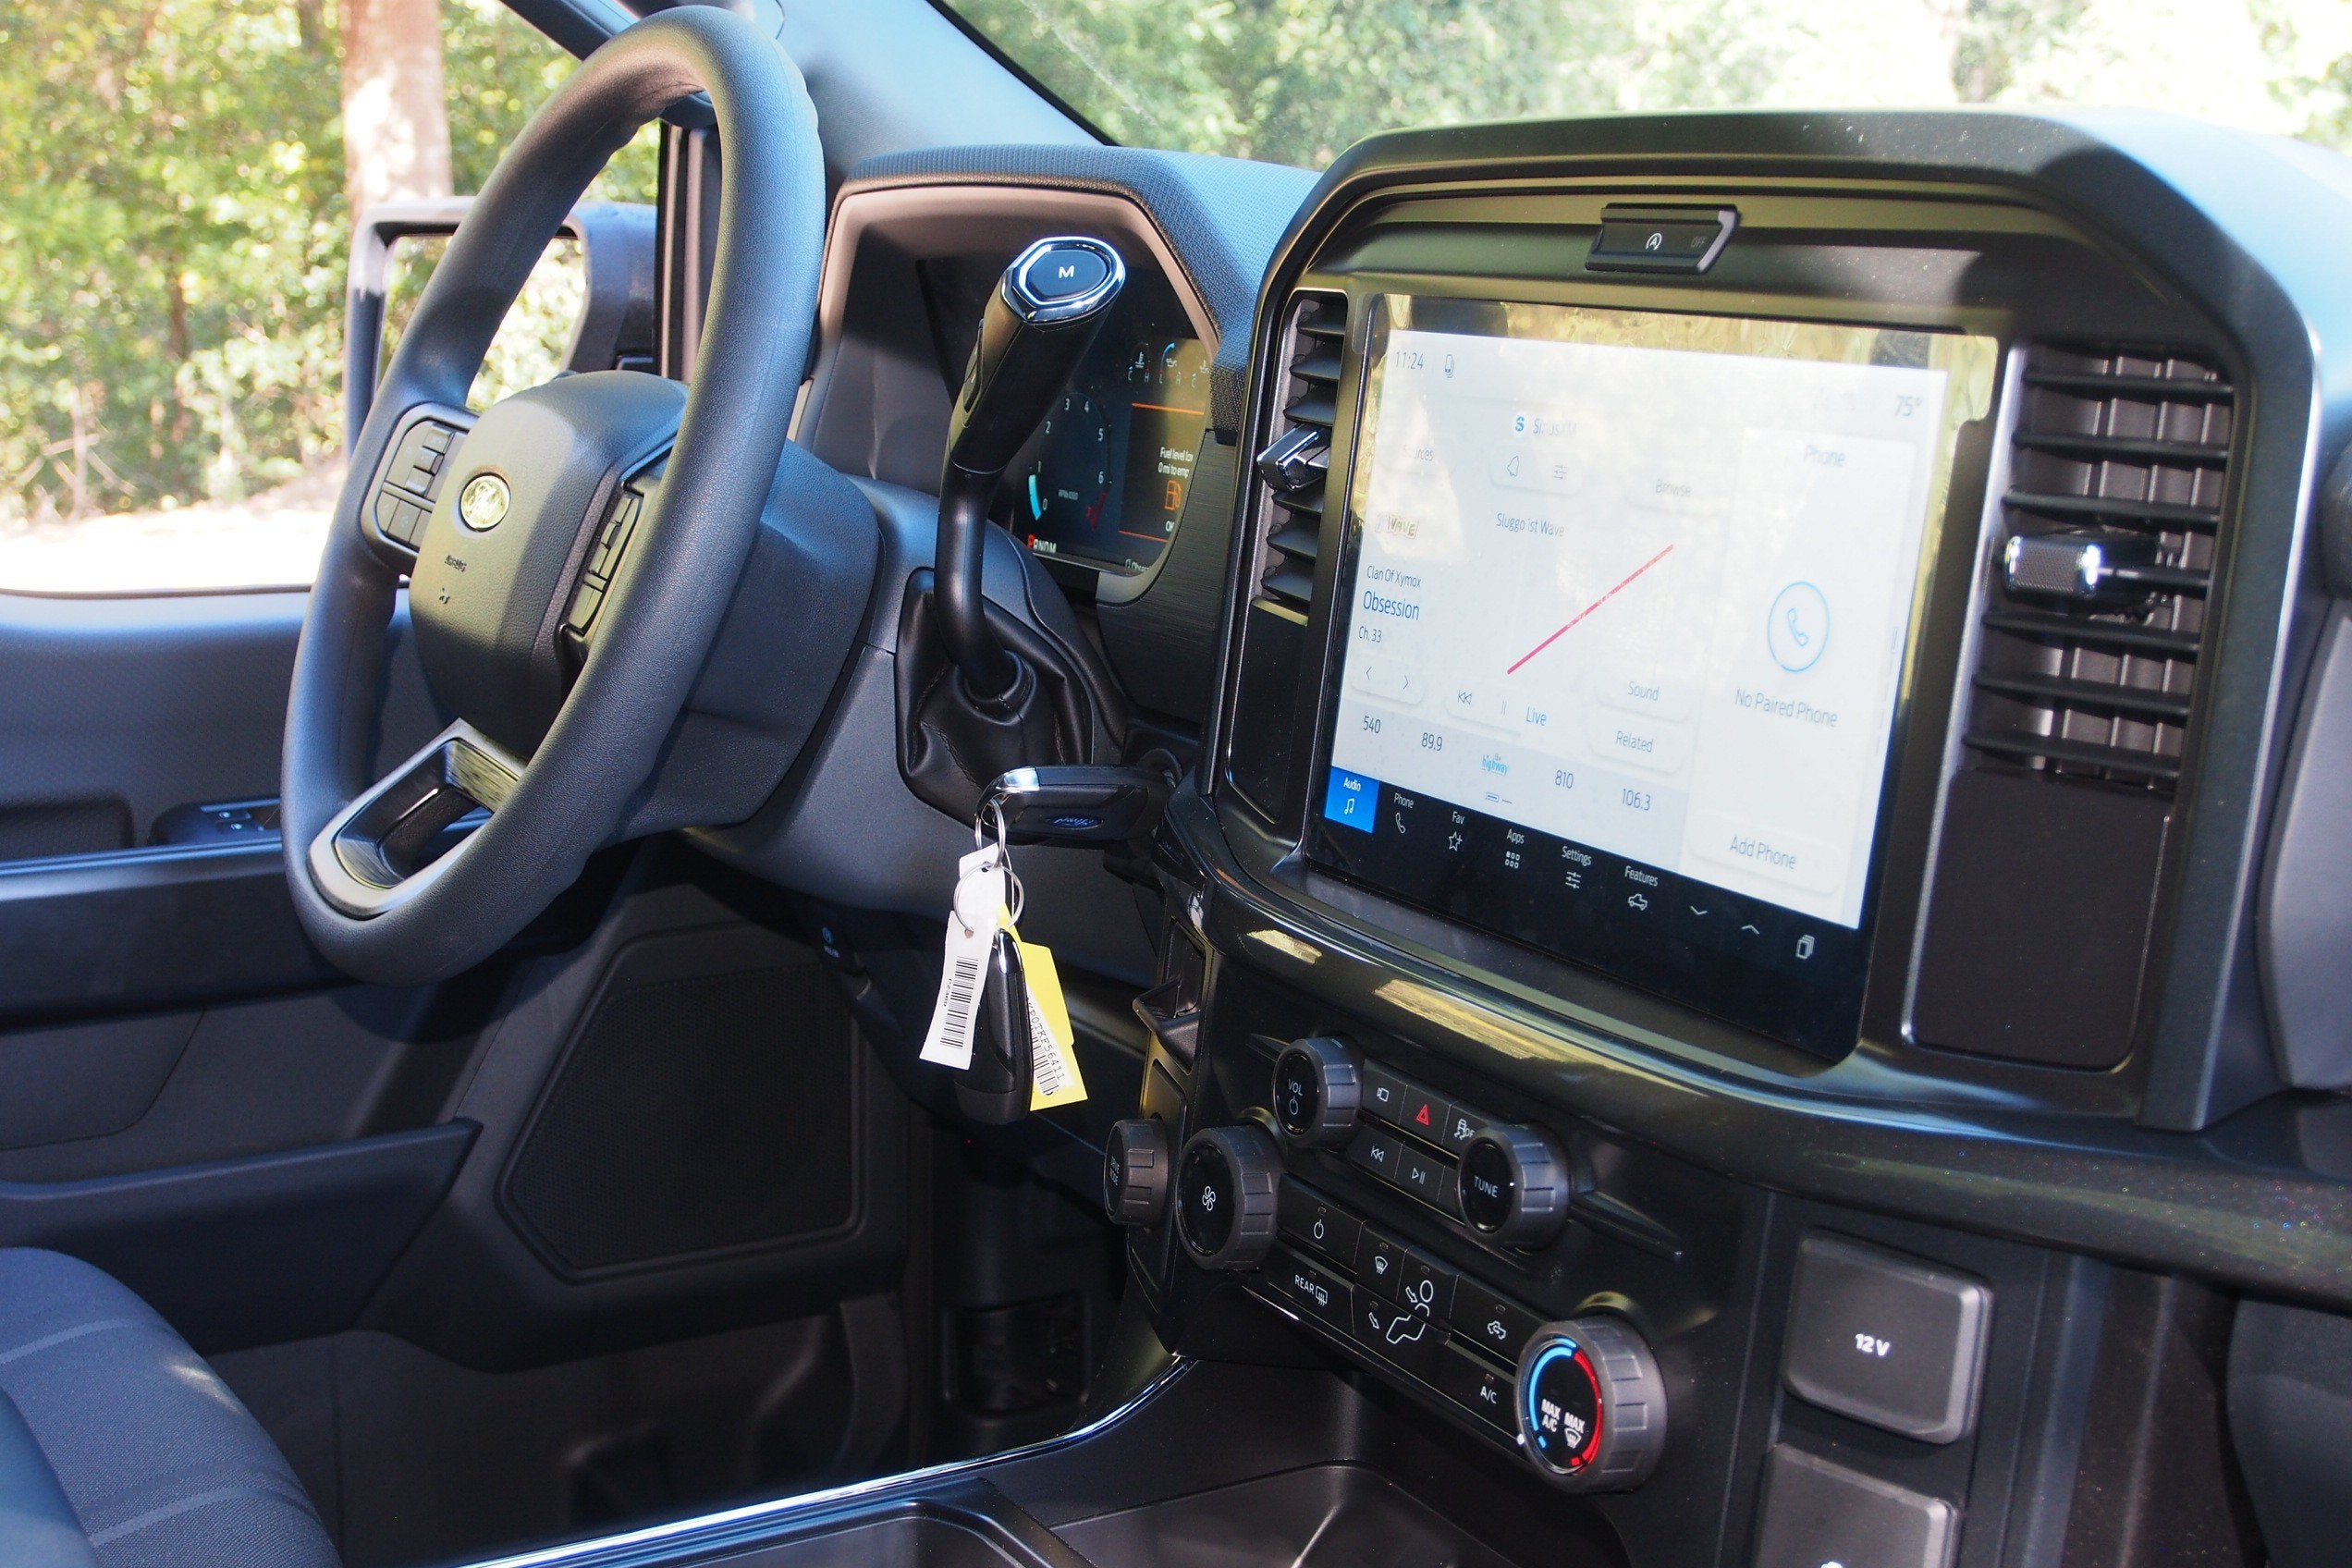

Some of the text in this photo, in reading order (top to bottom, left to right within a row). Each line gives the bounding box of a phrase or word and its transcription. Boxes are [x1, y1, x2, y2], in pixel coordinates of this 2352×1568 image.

[1059, 265, 1074, 278] M
[1395, 351, 1425, 371] 11:24
[1065, 398, 1071, 410] 3
[1084, 398, 1090, 412] 4
[1045, 421, 1051, 435] 2
[1097, 428, 1104, 442] 5
[1804, 445, 1845, 467] Phone
[1097, 471, 1104, 484] 6
[1042, 497, 1048, 511] 0
[1496, 512, 1525, 533] Sluggo
[1540, 521, 1565, 537] Wave
[1366, 565, 1422, 589] Clan Of Xymox
[1363, 590, 1420, 620] Obsession
[1371, 630, 1383, 643] 33
[1627, 680, 1660, 703] Sound
[1525, 706, 1547, 727] Live
[1734, 688, 1839, 729] No Paired Phone
[1363, 715, 1381, 734] 540
[1421, 731, 1443, 752] 89.9
[1615, 729, 1654, 753] Related
[1343, 777, 1362, 792] Audio
[1554, 769, 1574, 790] 810
[1393, 792, 1415, 810] Phone
[1622, 788, 1651, 812] 106.3
[1452, 811, 1465, 826] Fav
[1506, 828, 1525, 845] Apps
[1562, 846, 1592, 866] Settings
[1730, 835, 1797, 871] Add Phone
[1624, 865, 1659, 888] Features
[1287, 1078, 1304, 1096] VOL
[1474, 1174, 1499, 1198] TUNE
[1294, 1274, 1315, 1295] REAR
[1855, 1333, 1890, 1356] 12V
[1480, 1386, 1497, 1404] A/C
[1541, 1398, 1562, 1420] MAX
[1542, 1414, 1558, 1433] A/C
[1563, 1412, 1586, 1434] MAX
